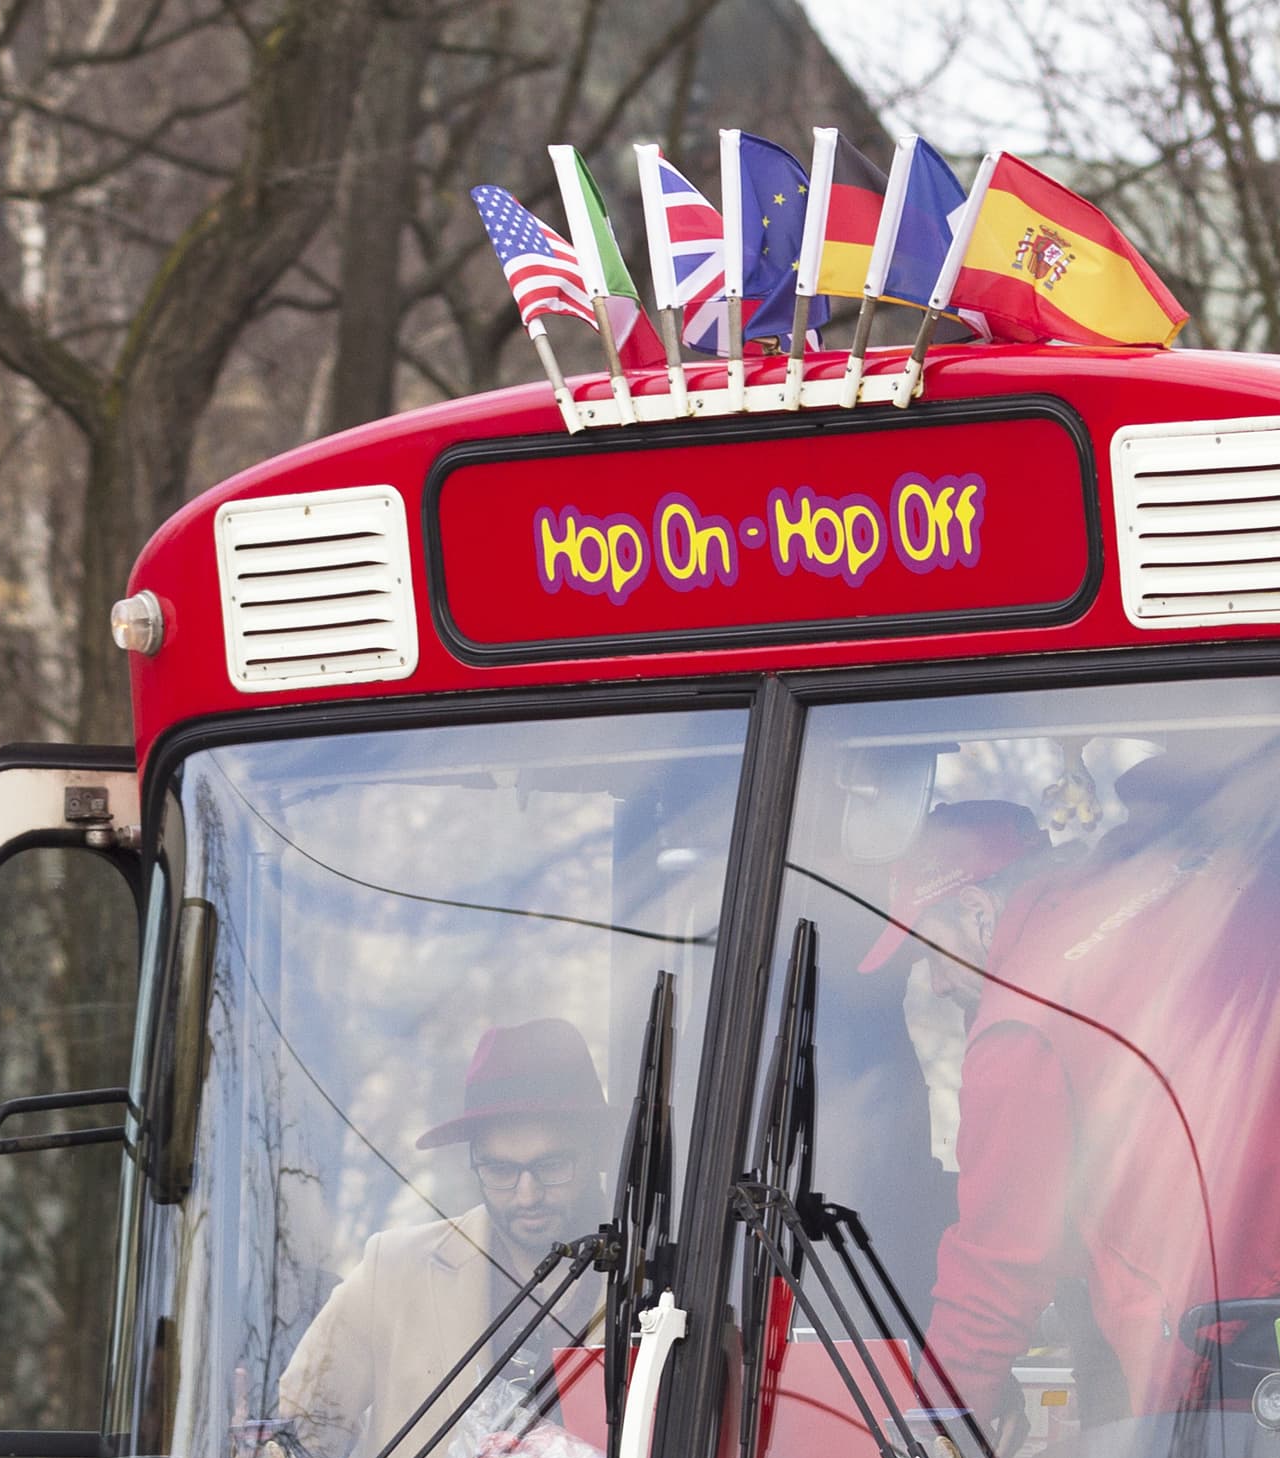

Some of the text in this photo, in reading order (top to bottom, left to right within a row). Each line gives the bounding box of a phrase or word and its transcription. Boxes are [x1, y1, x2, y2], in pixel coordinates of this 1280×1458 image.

[538, 514, 646, 595] Hop
[657, 500, 733, 581] On
[772, 494, 883, 577] Hop
[894, 481, 979, 563] Off
